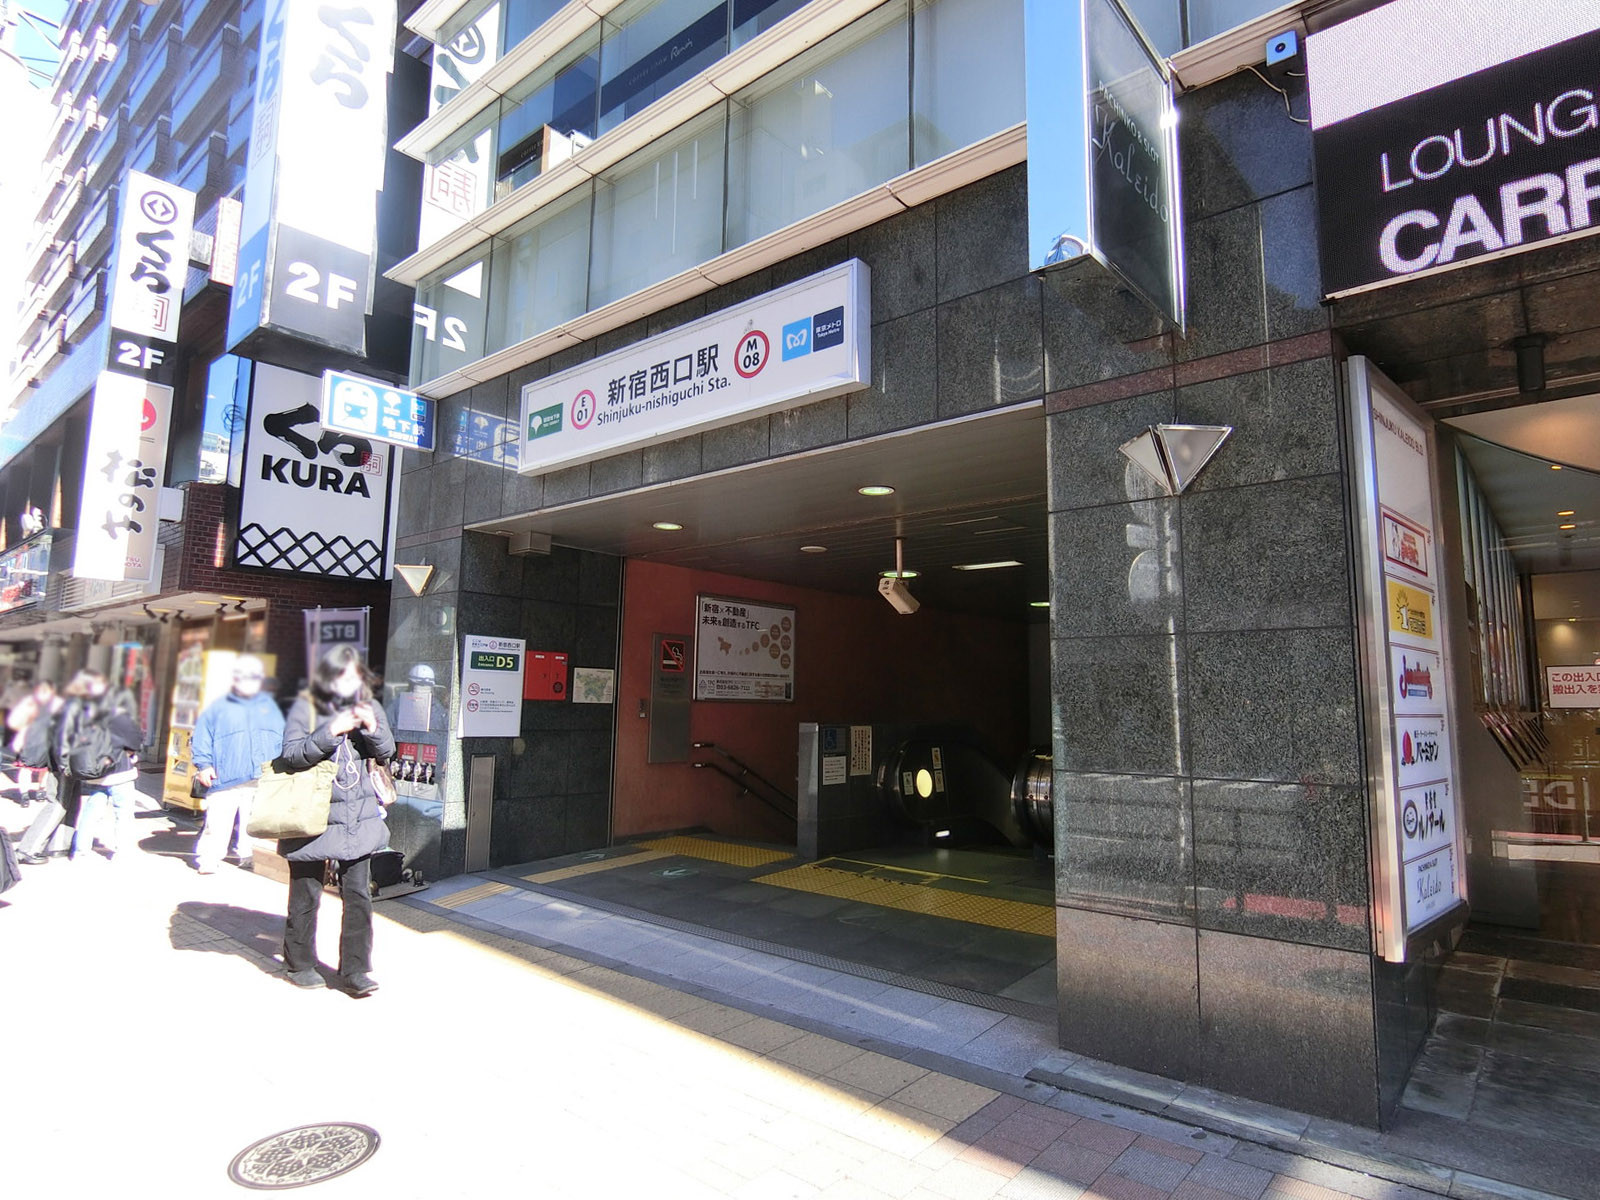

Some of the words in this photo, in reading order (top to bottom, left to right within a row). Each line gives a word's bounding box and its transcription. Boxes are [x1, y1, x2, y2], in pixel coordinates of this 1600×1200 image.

[1099, 80, 1137, 138] PACHINKO
[1143, 138, 1160, 166] SLOT
[1092, 104, 1169, 223] Kaleido
[236, 259, 261, 310] 2F
[285, 262, 358, 310] 2F
[746, 338, 758, 352] M
[815, 319, 842, 334] 東京メトロ
[117, 341, 165, 369] 2F
[743, 353, 760, 370] 08
[607, 343, 719, 406] 新宿西口駅
[576, 408, 589, 422] 01
[580, 396, 586, 407] E
[597, 383, 705, 427] Shinjuku-nishiguchi
[707, 375, 732, 395] Sta.
[260, 453, 371, 499] KURA
[496, 655, 514, 669] D5
